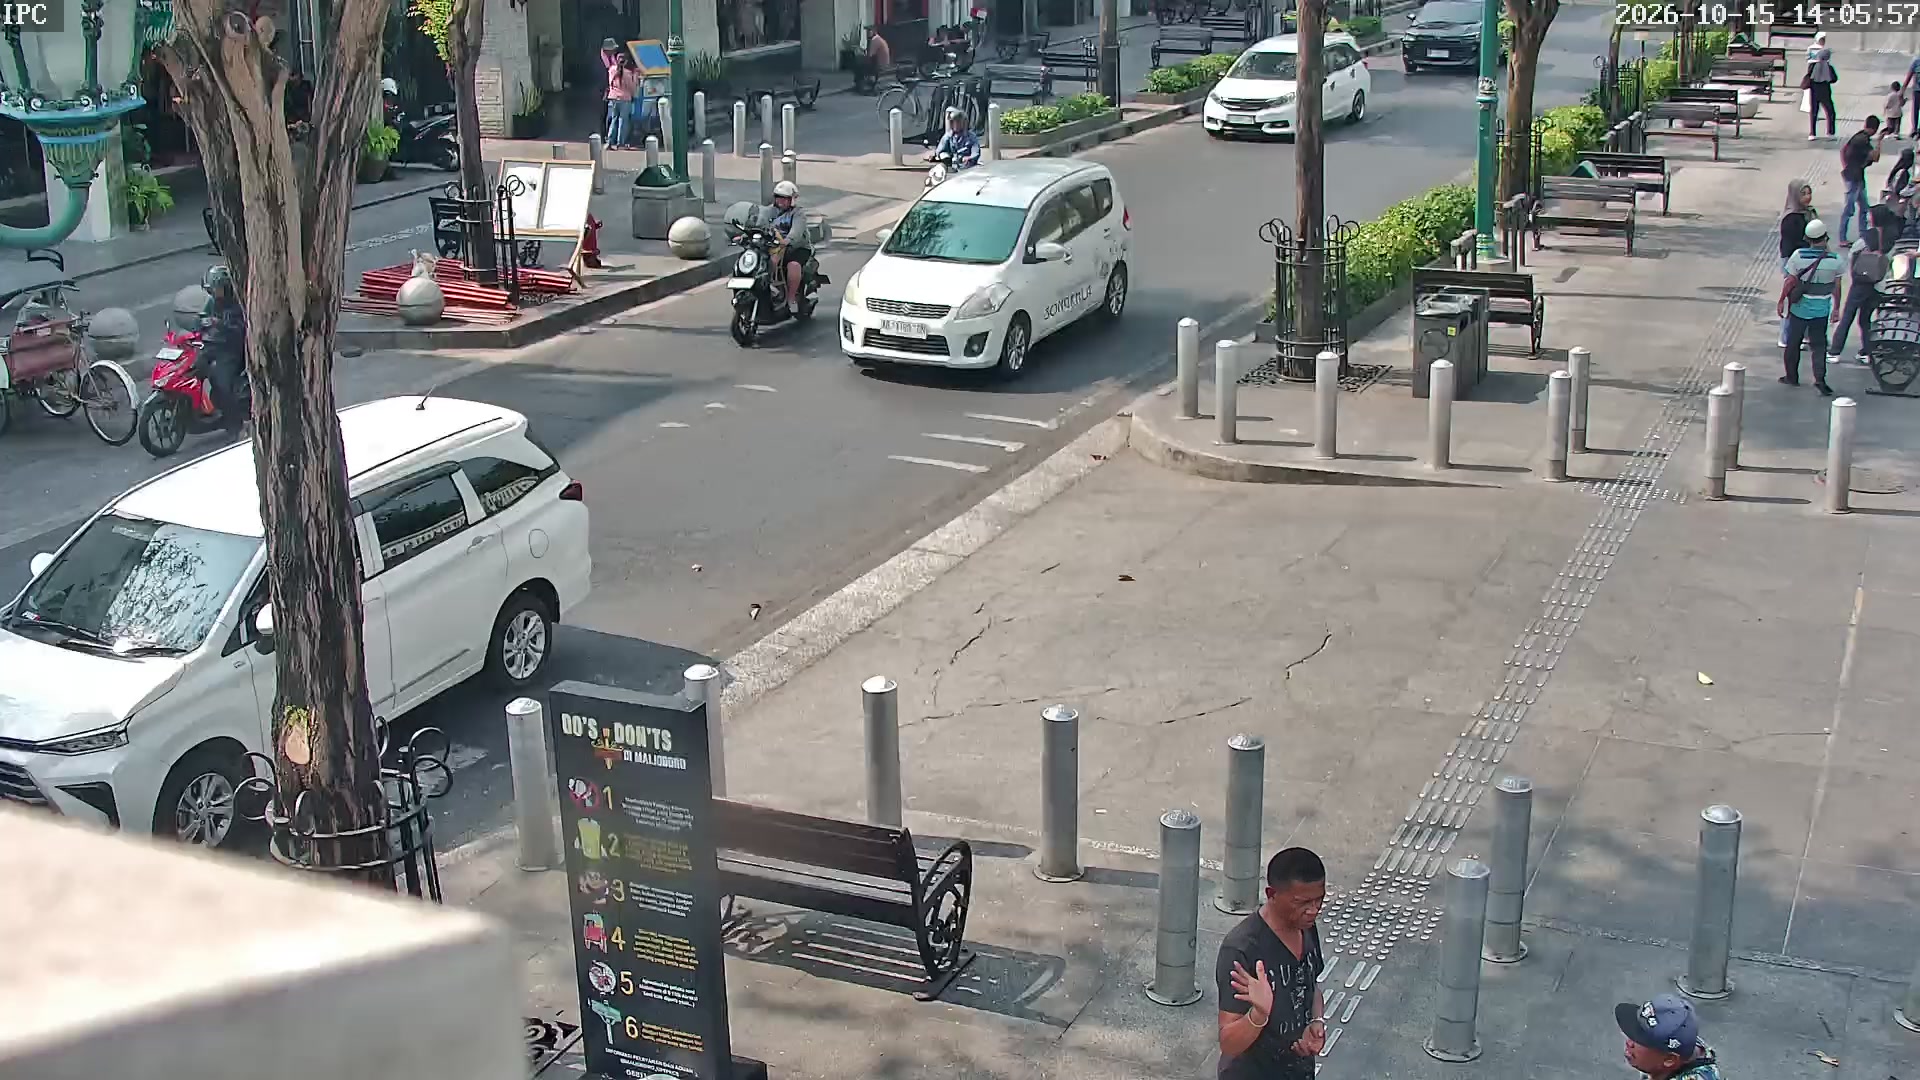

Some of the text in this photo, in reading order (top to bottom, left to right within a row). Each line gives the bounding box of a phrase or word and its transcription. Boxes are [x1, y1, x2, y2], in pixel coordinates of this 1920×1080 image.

[561, 713, 672, 752] DO'S DON'TS
[602, 786, 613, 811] 1
[608, 832, 620, 858] 2
[612, 878, 625, 902] 3
[611, 926, 626, 951] 4
[620, 971, 635, 995] 5
[625, 1016, 639, 1039] 6
